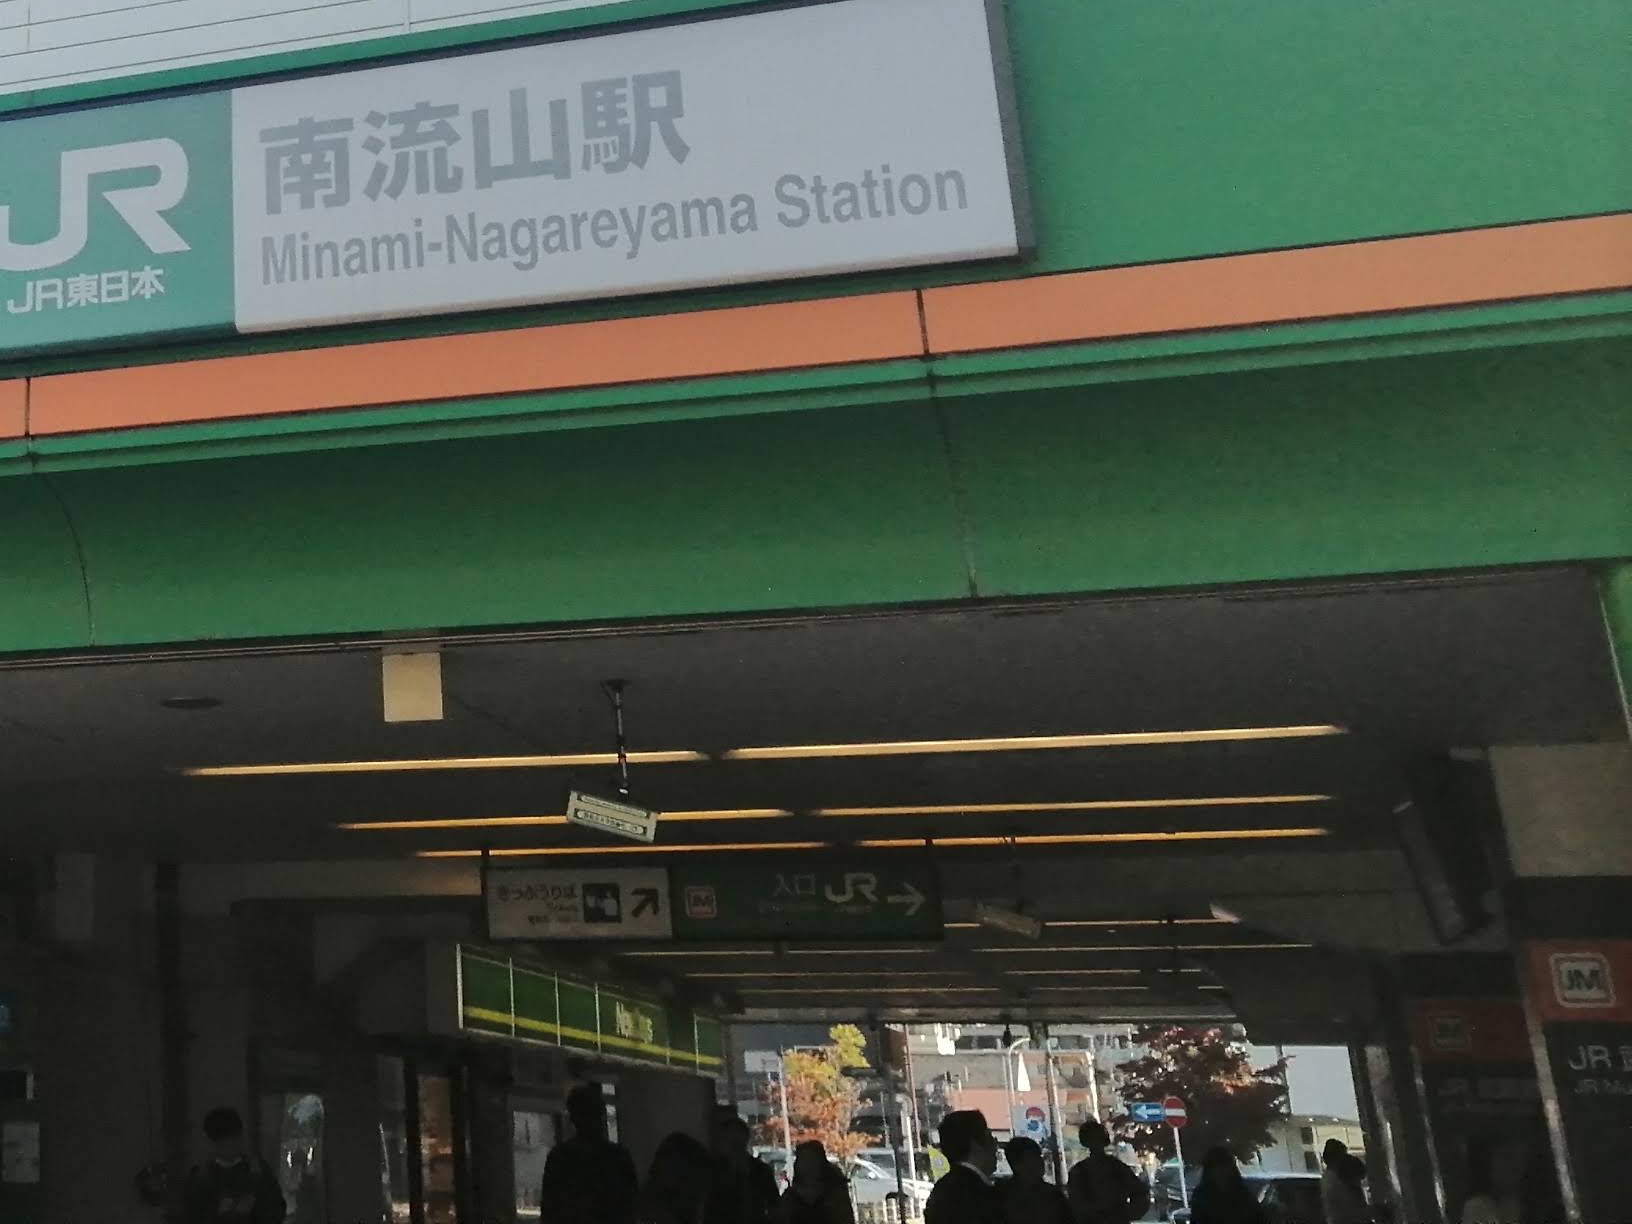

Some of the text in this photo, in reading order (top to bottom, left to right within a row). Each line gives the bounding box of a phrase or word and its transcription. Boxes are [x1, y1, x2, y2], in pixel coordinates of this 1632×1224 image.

[259, 70, 690, 215] 南流山駅
[261, 162, 968, 285] Minami-Nagareyama Station
[7, 265, 166, 314] JR東日本
[772, 872, 816, 897] 入口
[824, 872, 880, 903] JR
